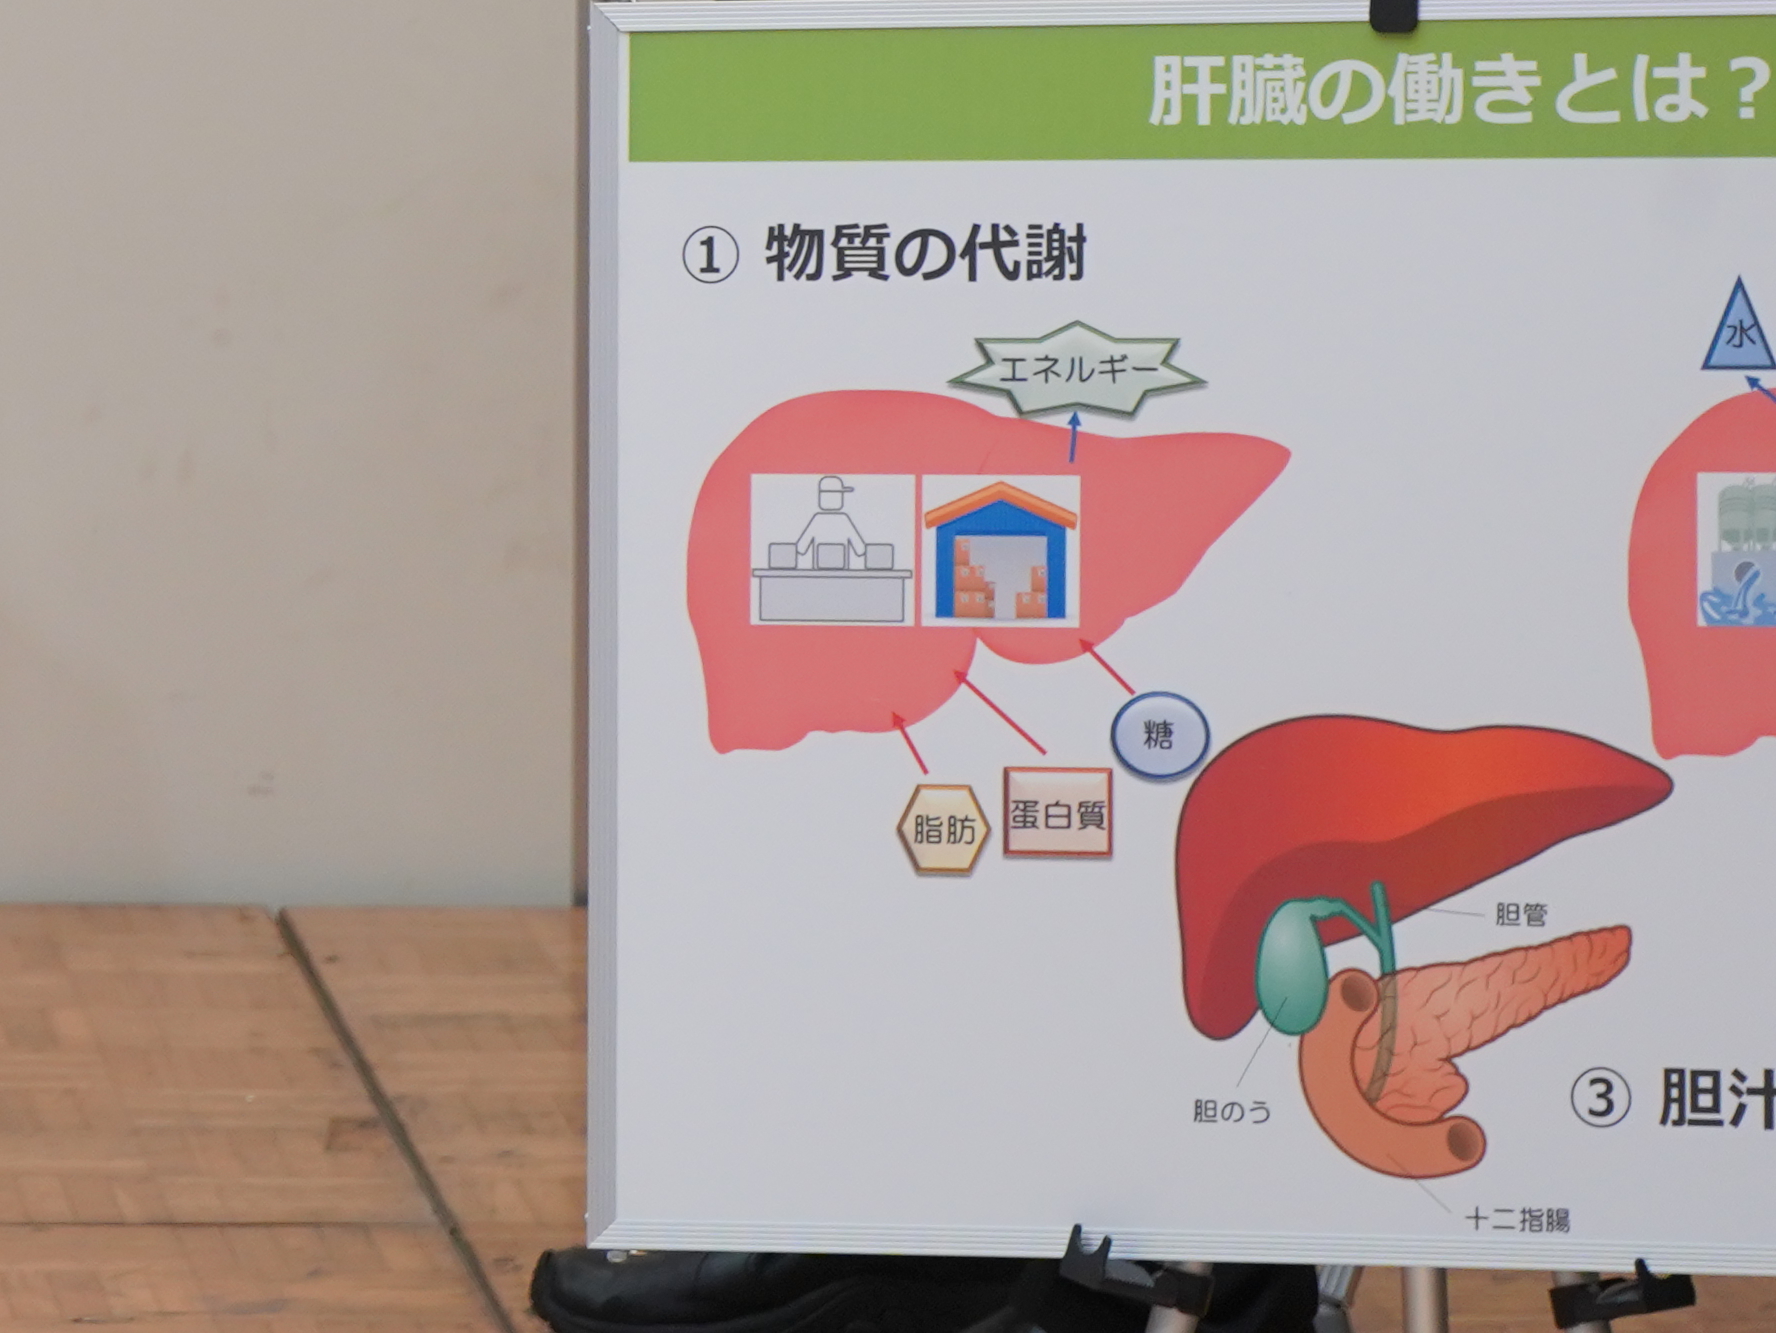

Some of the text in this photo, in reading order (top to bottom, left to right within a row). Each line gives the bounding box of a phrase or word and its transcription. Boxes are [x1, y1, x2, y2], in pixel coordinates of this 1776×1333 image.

[1148, 51, 1772, 127] 肝臓の働きとは？
[765, 222, 1088, 283] 物質の代謝
[1725, 319, 1757, 349] 水
[1000, 354, 1159, 384] エネルギー
[1143, 719, 1174, 750] 糖
[913, 814, 977, 846] 脂肪
[1010, 800, 1107, 831] 蛋白質
[1496, 902, 1548, 927] 胆管
[1193, 1098, 1272, 1124] 胆のう
[1659, 1067, 1776, 1131] 胆汁
[1465, 1206, 1571, 1234] 十二指腸
